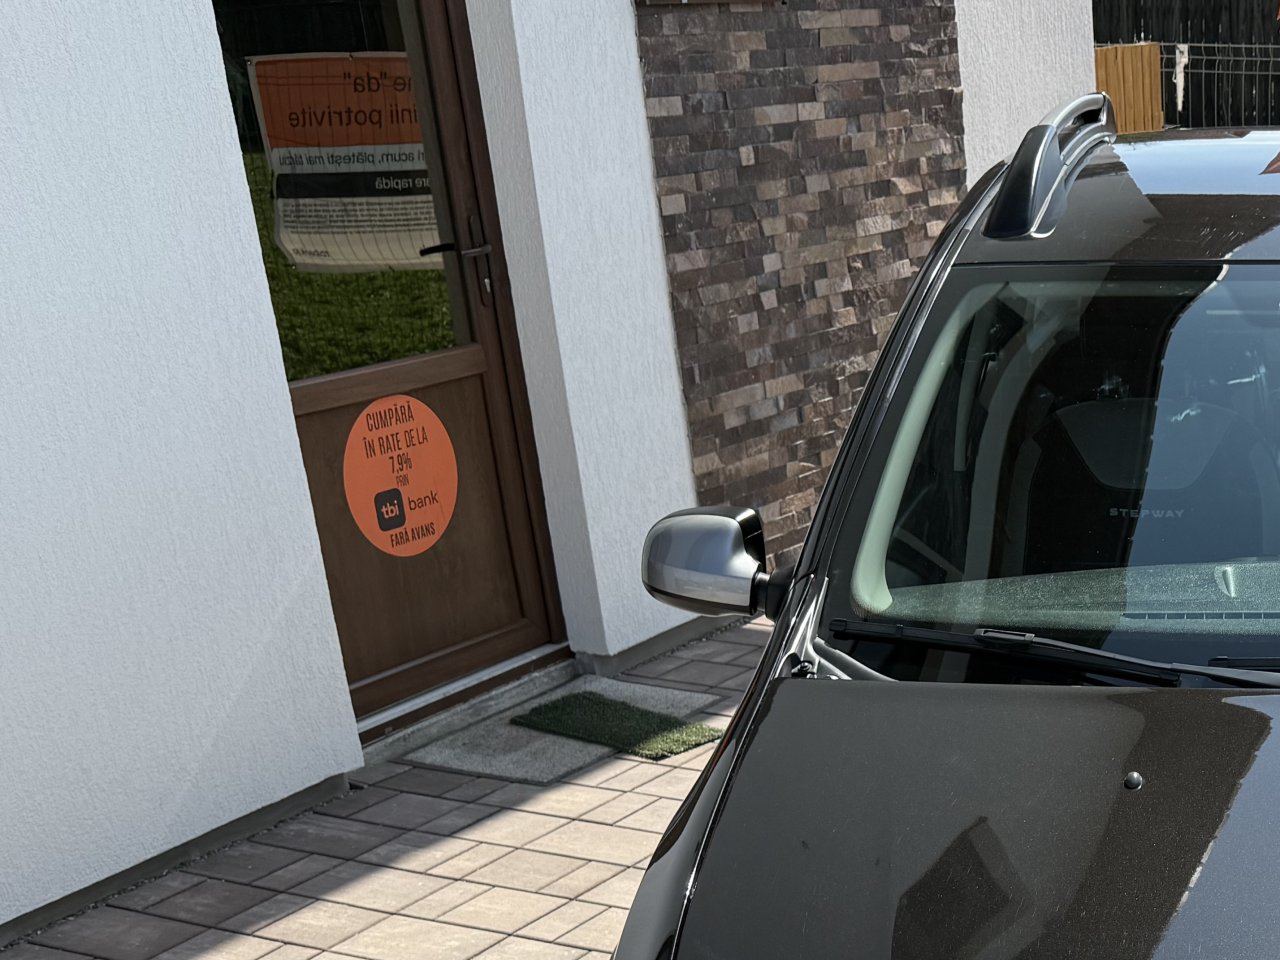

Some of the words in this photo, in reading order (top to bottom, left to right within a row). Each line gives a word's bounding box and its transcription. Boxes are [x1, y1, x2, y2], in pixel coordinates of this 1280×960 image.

[365, 401, 415, 432] CUMPĂRĂ
[363, 434, 377, 459] ÎN
[378, 433, 402, 456] RATE
[404, 429, 417, 448] DE
[417, 426, 429, 445] LA
[381, 500, 400, 518] tbi
[408, 490, 440, 511] bank
[411, 521, 436, 543] AVANS
